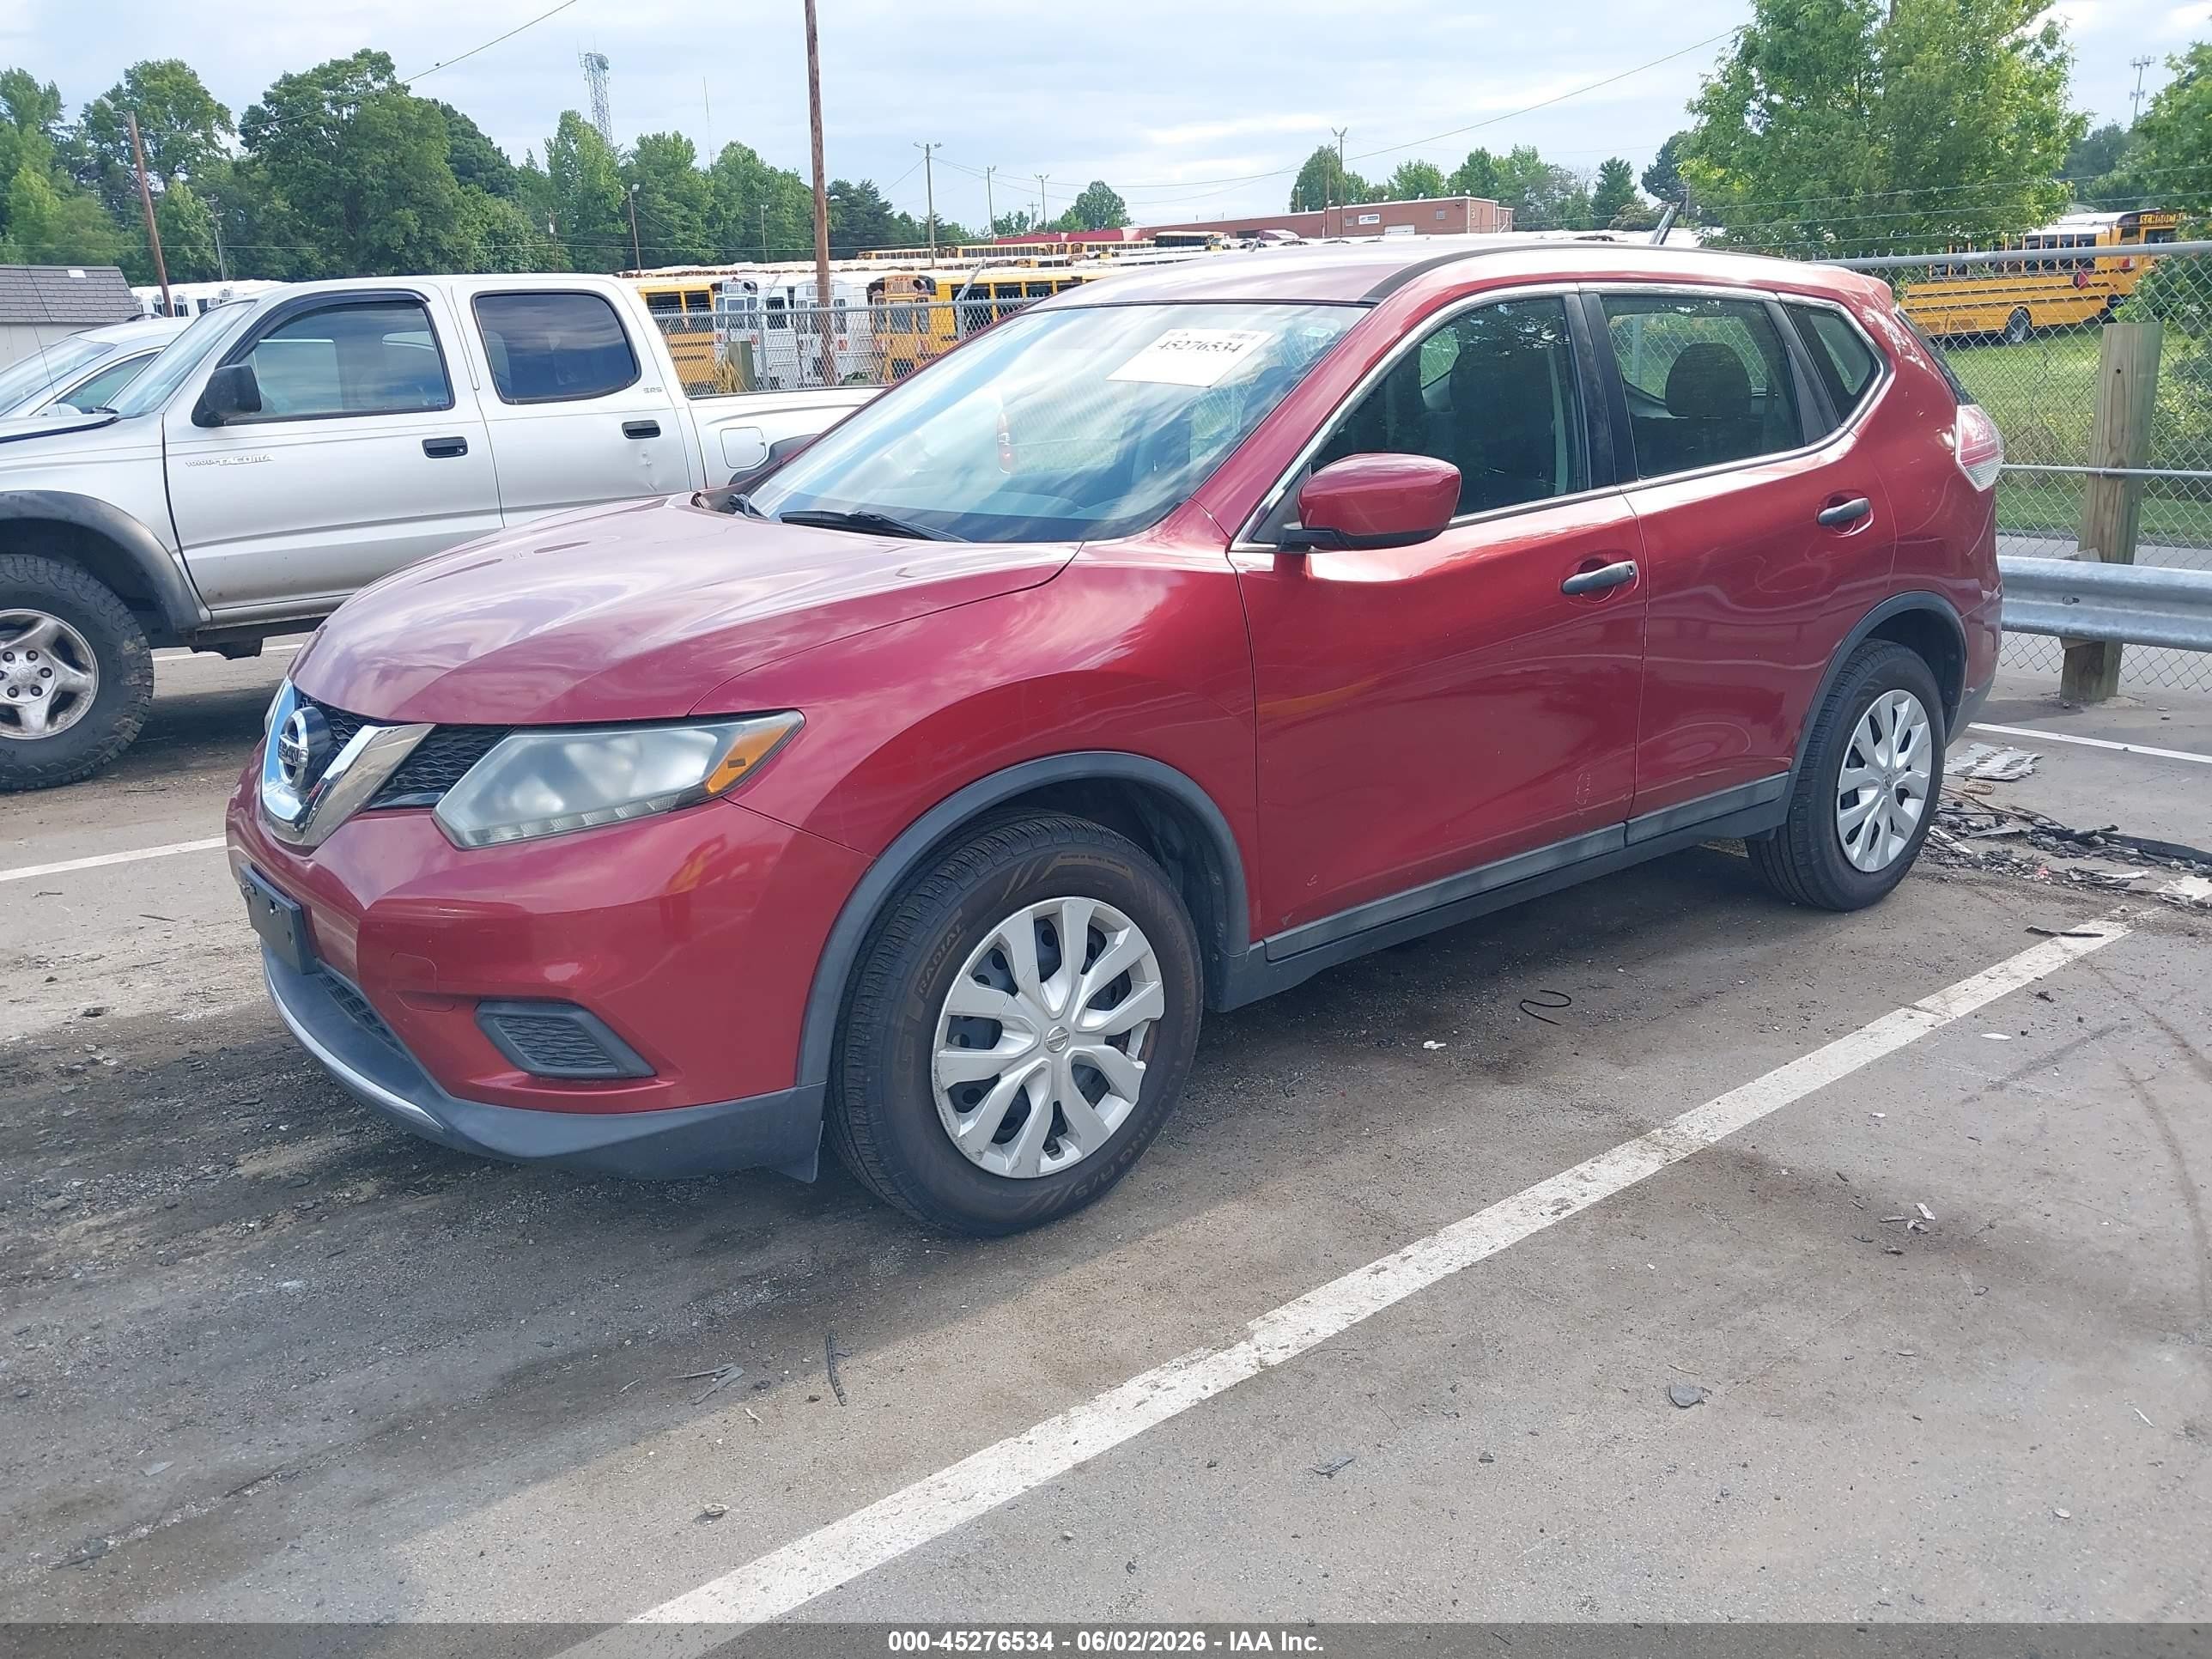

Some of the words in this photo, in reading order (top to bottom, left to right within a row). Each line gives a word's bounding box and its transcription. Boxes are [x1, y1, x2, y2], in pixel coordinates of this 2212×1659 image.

[2140, 213, 2176, 225] SCHOOL
[1158, 340, 1244, 353] 45276534
[217, 453, 275, 465] TACOMA
[917, 922, 965, 996] RADIAL
